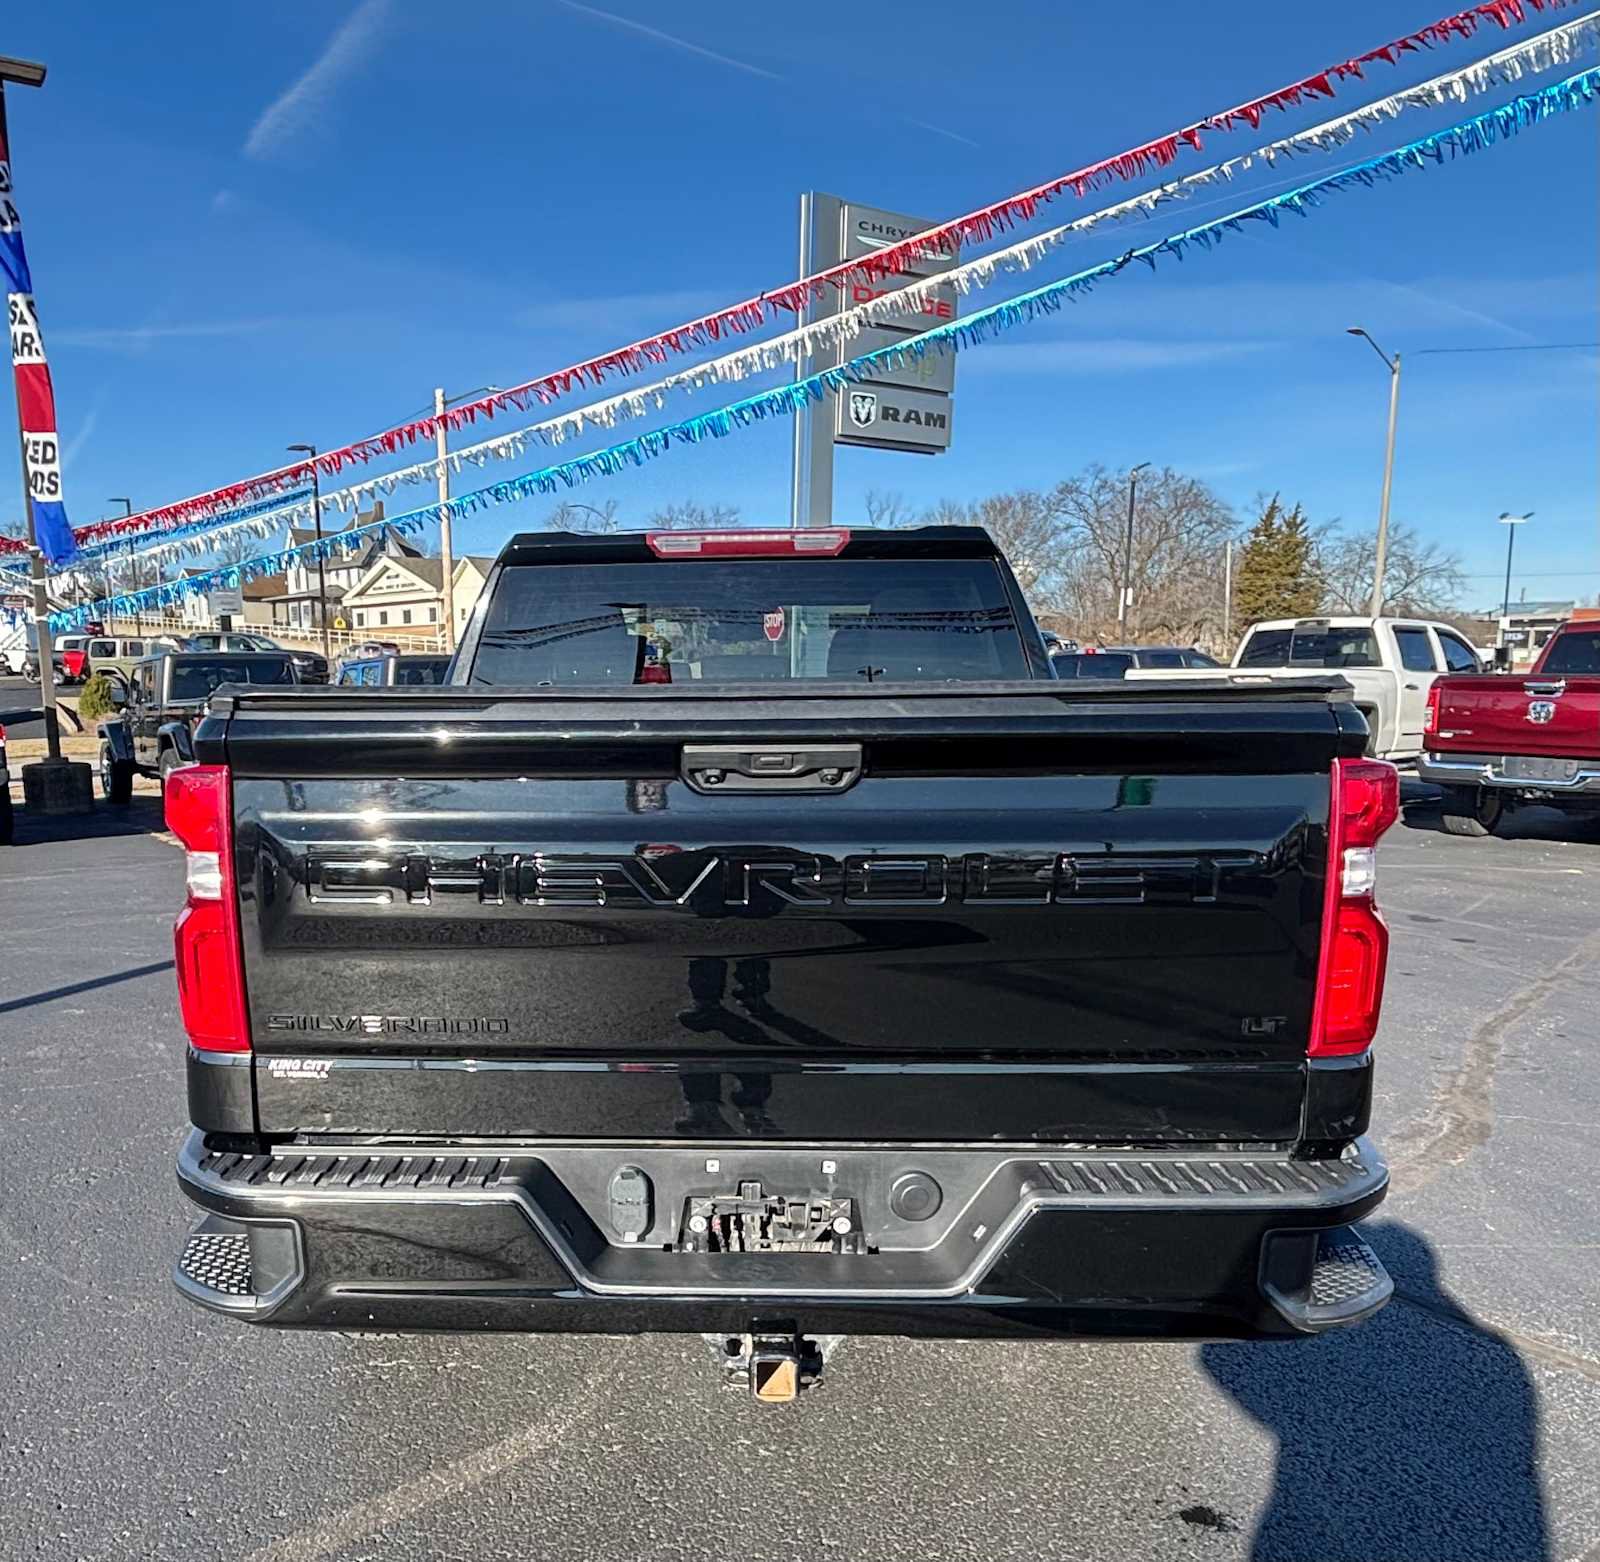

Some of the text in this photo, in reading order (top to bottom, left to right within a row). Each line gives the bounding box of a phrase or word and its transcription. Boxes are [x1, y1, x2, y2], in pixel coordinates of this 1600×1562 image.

[881, 405, 946, 429] RAM
[764, 613, 784, 628] STOP
[306, 852, 1264, 904] CHEVROLET
[267, 1015, 509, 1034] SILVERADO
[1241, 1016, 1288, 1035] LT
[268, 1059, 334, 1072] KING CITY
